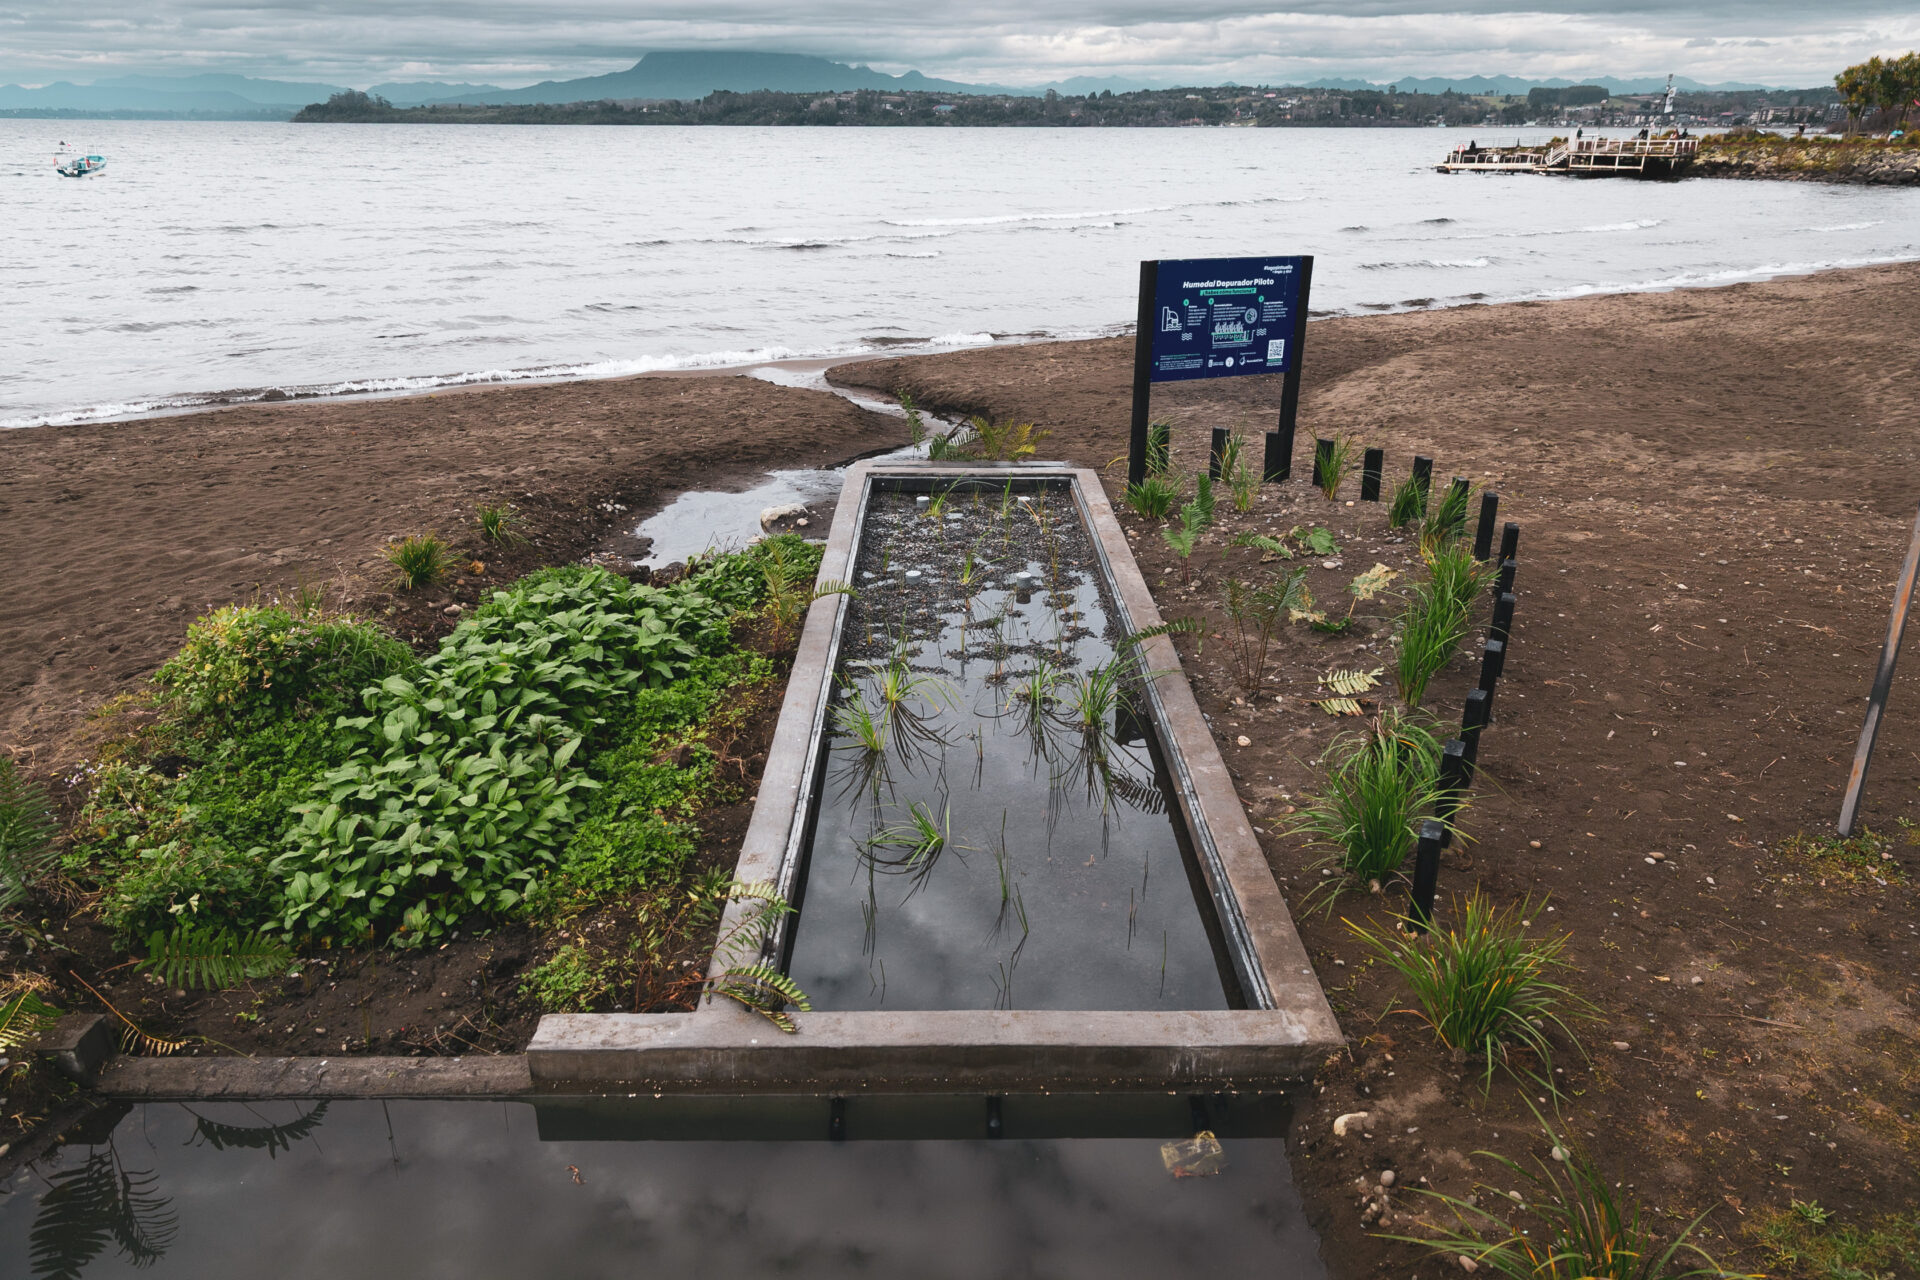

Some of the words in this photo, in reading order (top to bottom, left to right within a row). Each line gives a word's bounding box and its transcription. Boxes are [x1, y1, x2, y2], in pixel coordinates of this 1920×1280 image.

[1183, 280, 1216, 288] Humedal
[1216, 279, 1254, 288] Depurador
[1254, 278, 1275, 286] Piloto
